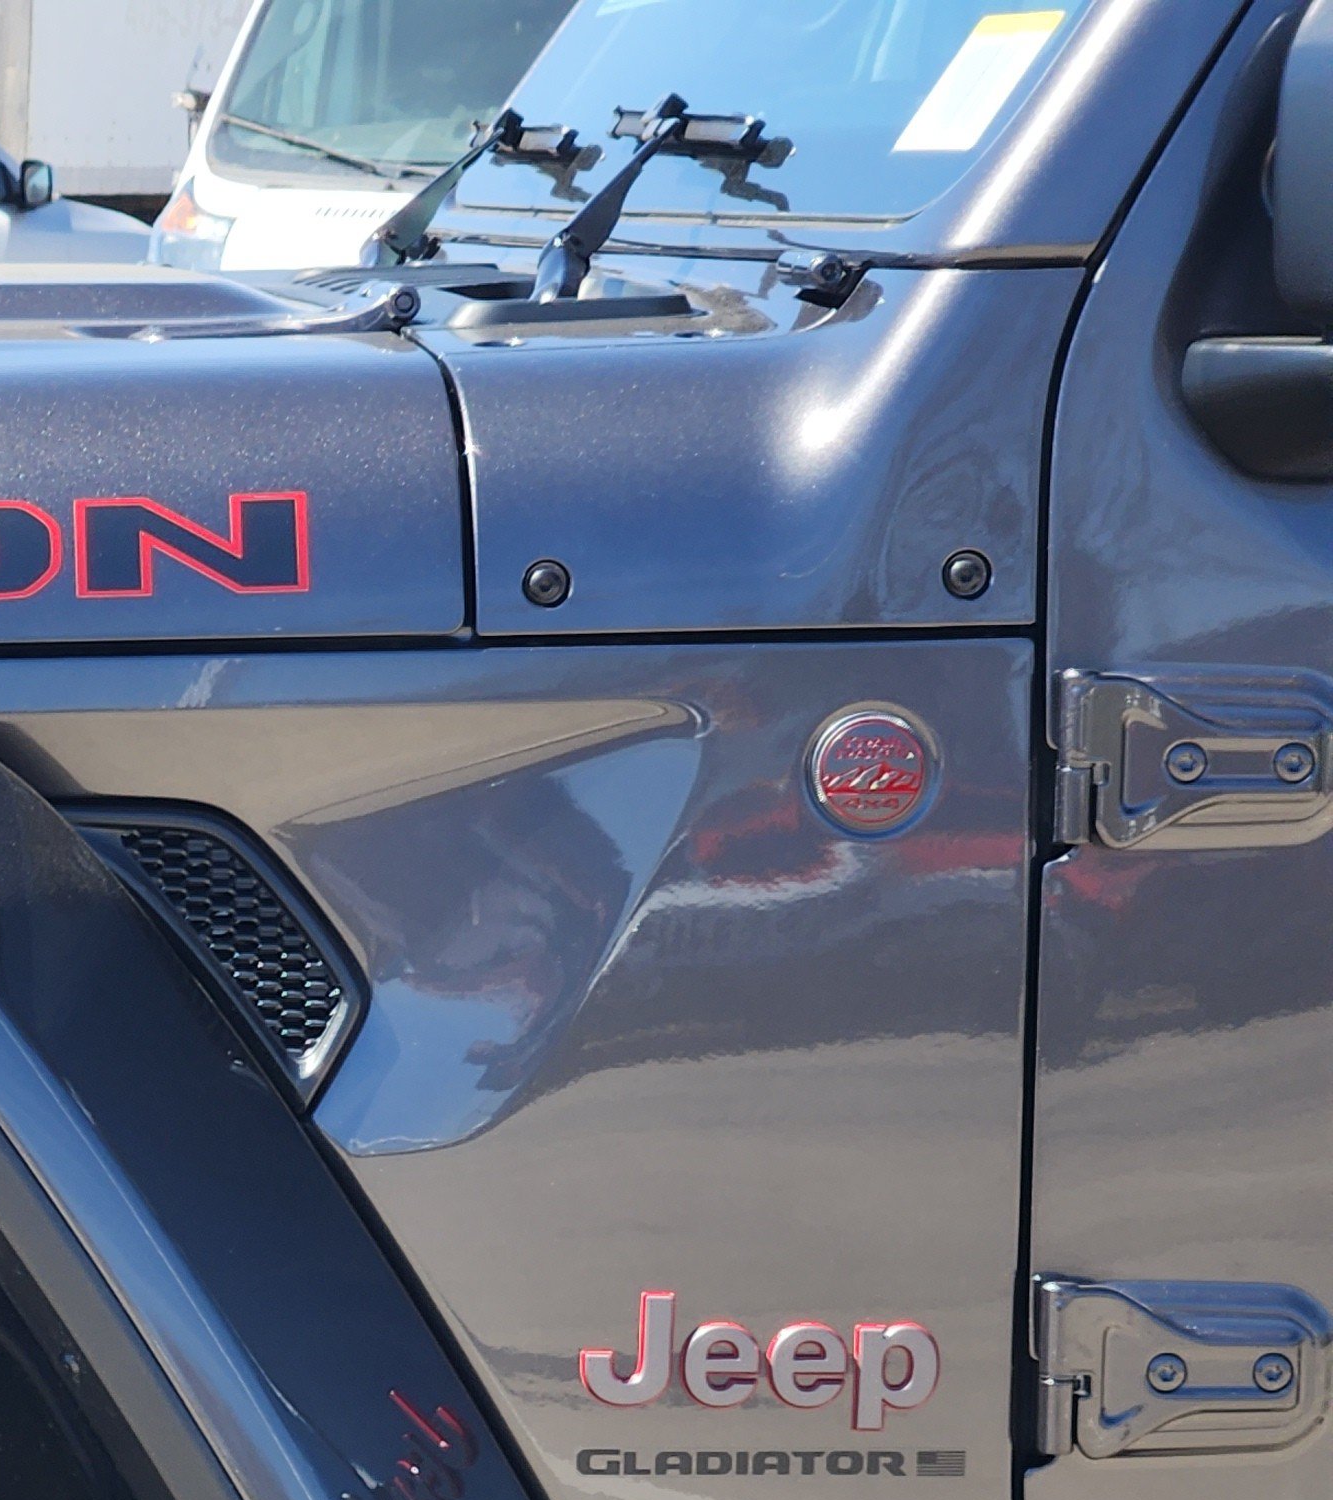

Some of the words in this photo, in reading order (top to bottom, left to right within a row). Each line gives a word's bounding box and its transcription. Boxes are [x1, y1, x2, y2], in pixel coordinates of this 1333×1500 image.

[842, 797, 900, 809] 4x4
[578, 1290, 941, 1431] Jeep
[575, 1448, 906, 1477] GLADIATOR
